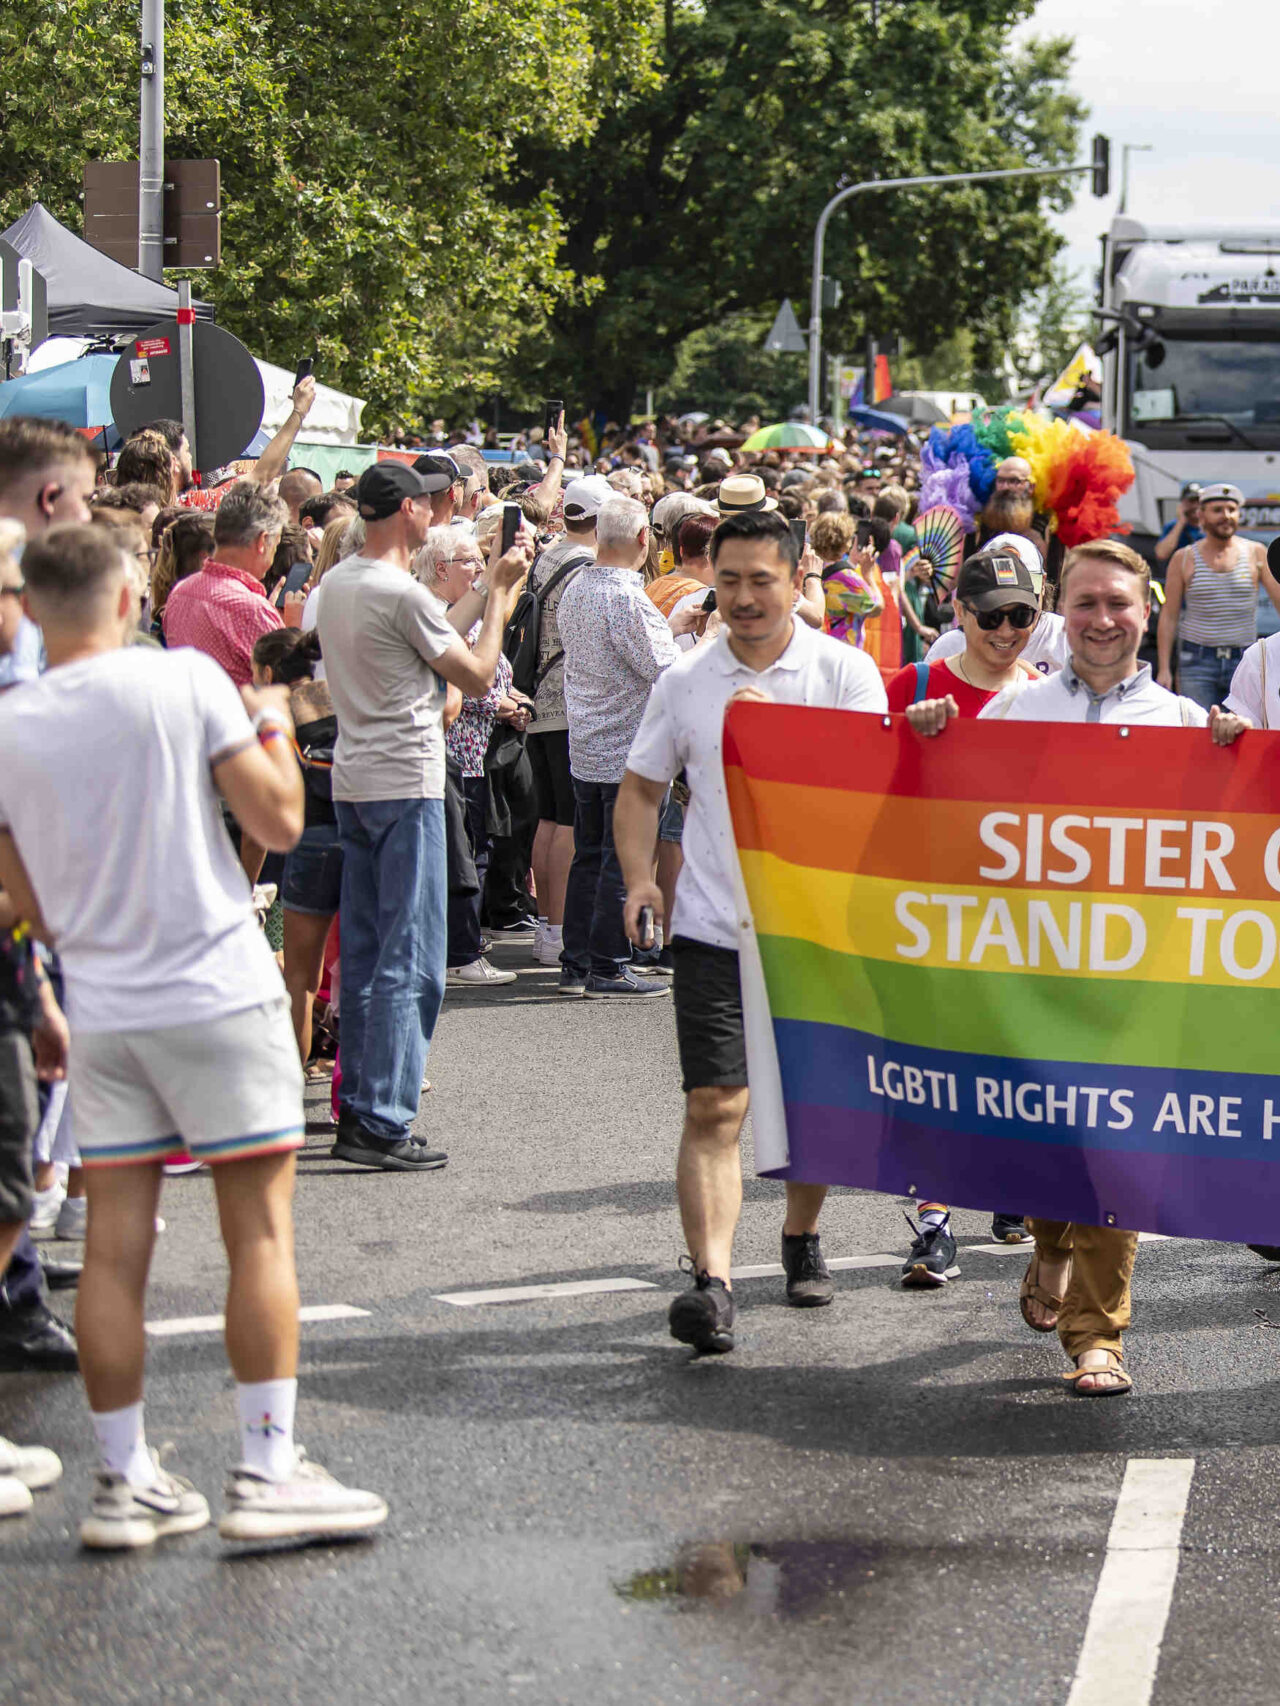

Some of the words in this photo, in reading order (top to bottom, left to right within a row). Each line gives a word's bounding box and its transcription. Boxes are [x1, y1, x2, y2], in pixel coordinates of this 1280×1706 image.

[979, 811, 1237, 891] SISTER
[894, 890, 1148, 972] STAND
[867, 1055, 958, 1112] LGBTI
[976, 1077, 1135, 1130] RIGHTS
[1152, 1092, 1242, 1138] ARE
